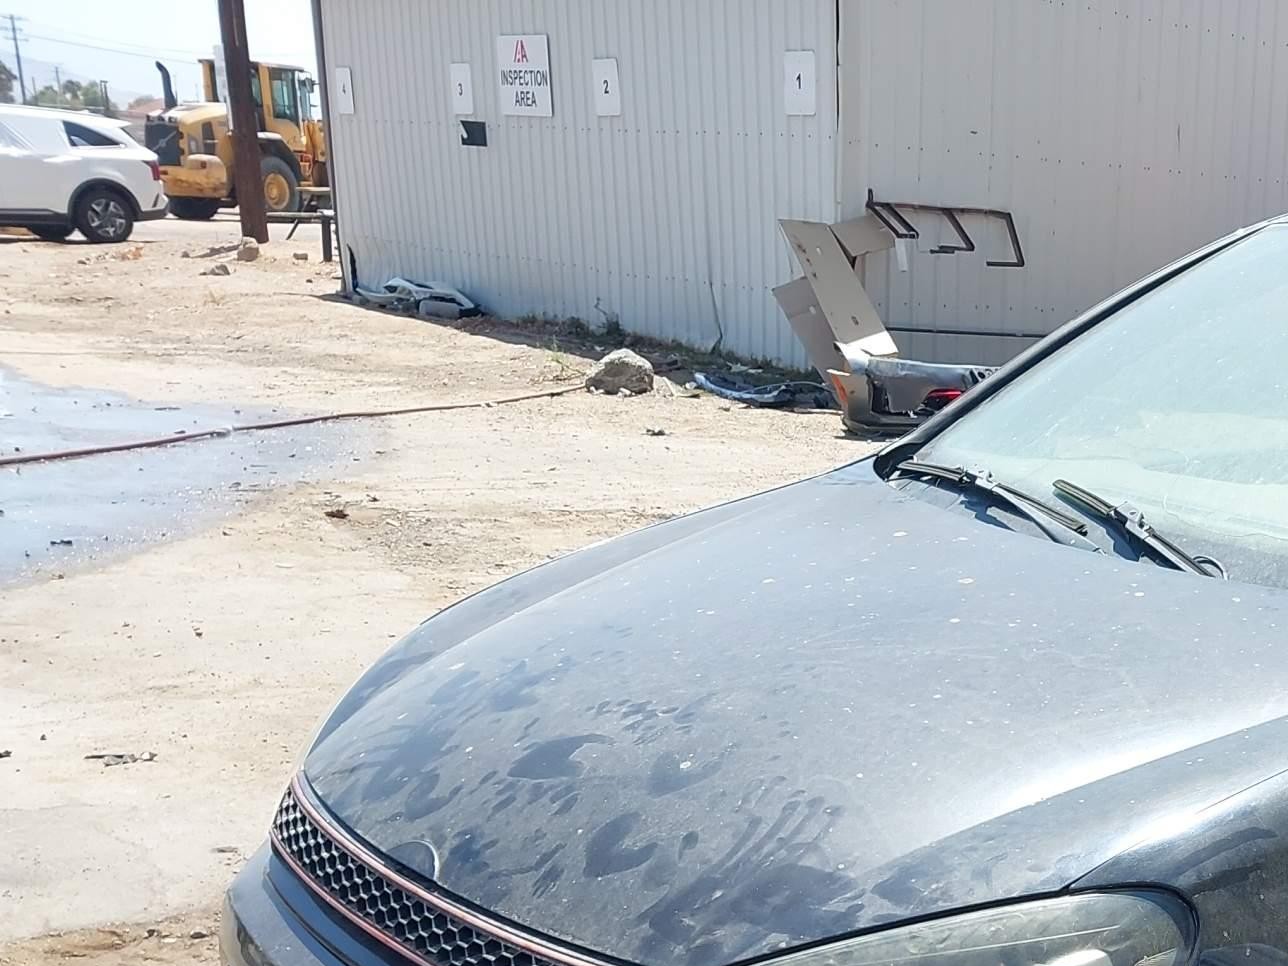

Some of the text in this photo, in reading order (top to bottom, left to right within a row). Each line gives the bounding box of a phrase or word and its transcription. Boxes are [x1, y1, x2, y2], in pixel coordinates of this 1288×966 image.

[500, 69, 548, 87] INSPECTION
[796, 73, 801, 89] 1
[458, 83, 463, 96] 3
[603, 80, 609, 94] 2
[515, 91, 537, 107] AREA
